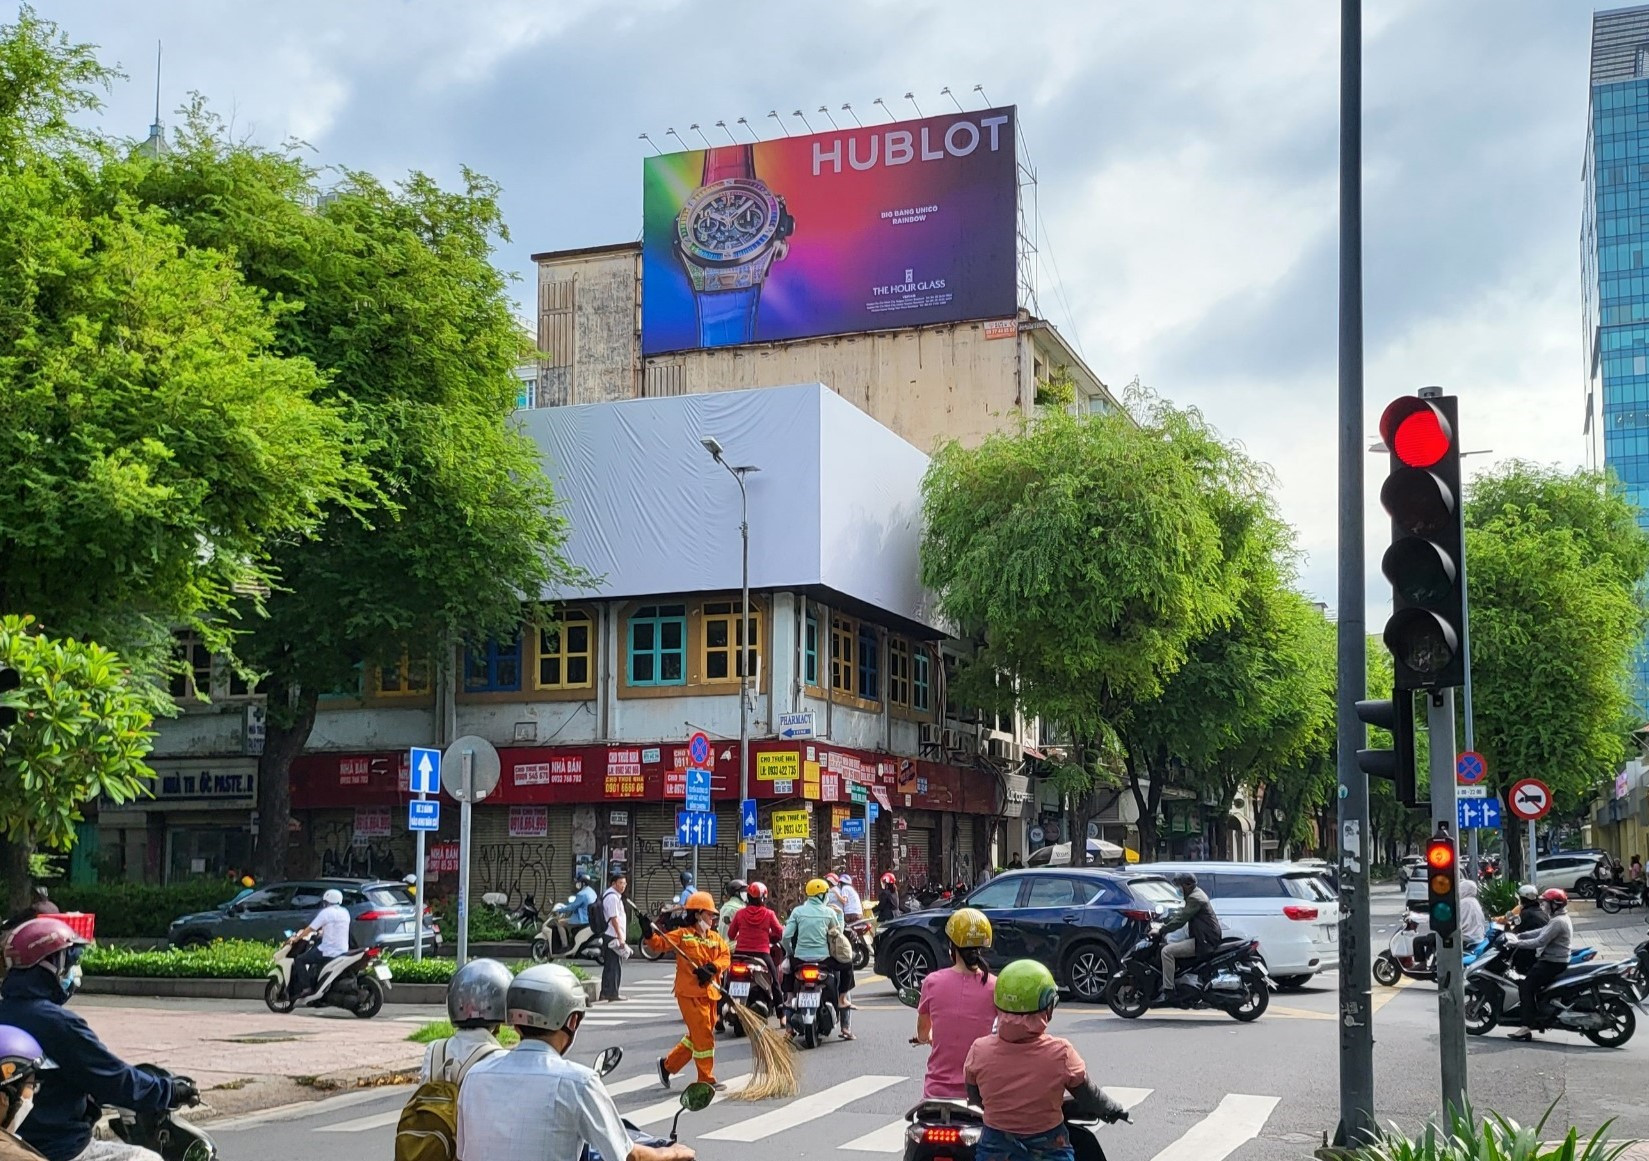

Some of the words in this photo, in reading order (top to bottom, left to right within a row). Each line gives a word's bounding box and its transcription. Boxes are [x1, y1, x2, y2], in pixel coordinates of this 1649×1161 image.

[812, 115, 1009, 176] HUBLOT
[880, 211, 893, 219] BIG
[894, 208, 915, 217] BANG
[915, 205, 938, 215] UNICO
[892, 214, 927, 225] RAINBOW
[873, 287, 889, 296] THE
[890, 282, 916, 294] HOUR
[917, 279, 946, 291] GLASS
[780, 713, 812, 726] PHARMACY
[772, 755, 784, 763] THUÊ
[785, 754, 797, 762] NHÀ
[355, 760, 368, 774] BÁN
[551, 757, 565, 774] NHÀ
[567, 757, 582, 773] BÁN
[767, 766, 779, 776] 0933
[779, 766, 787, 775] 422
[788, 765, 797, 775] 735
[605, 783, 620, 793] 0901
[783, 825, 795, 835] 0933
[843, 825, 862, 833] PASTEUR
[445, 845, 458, 859] BÁN
